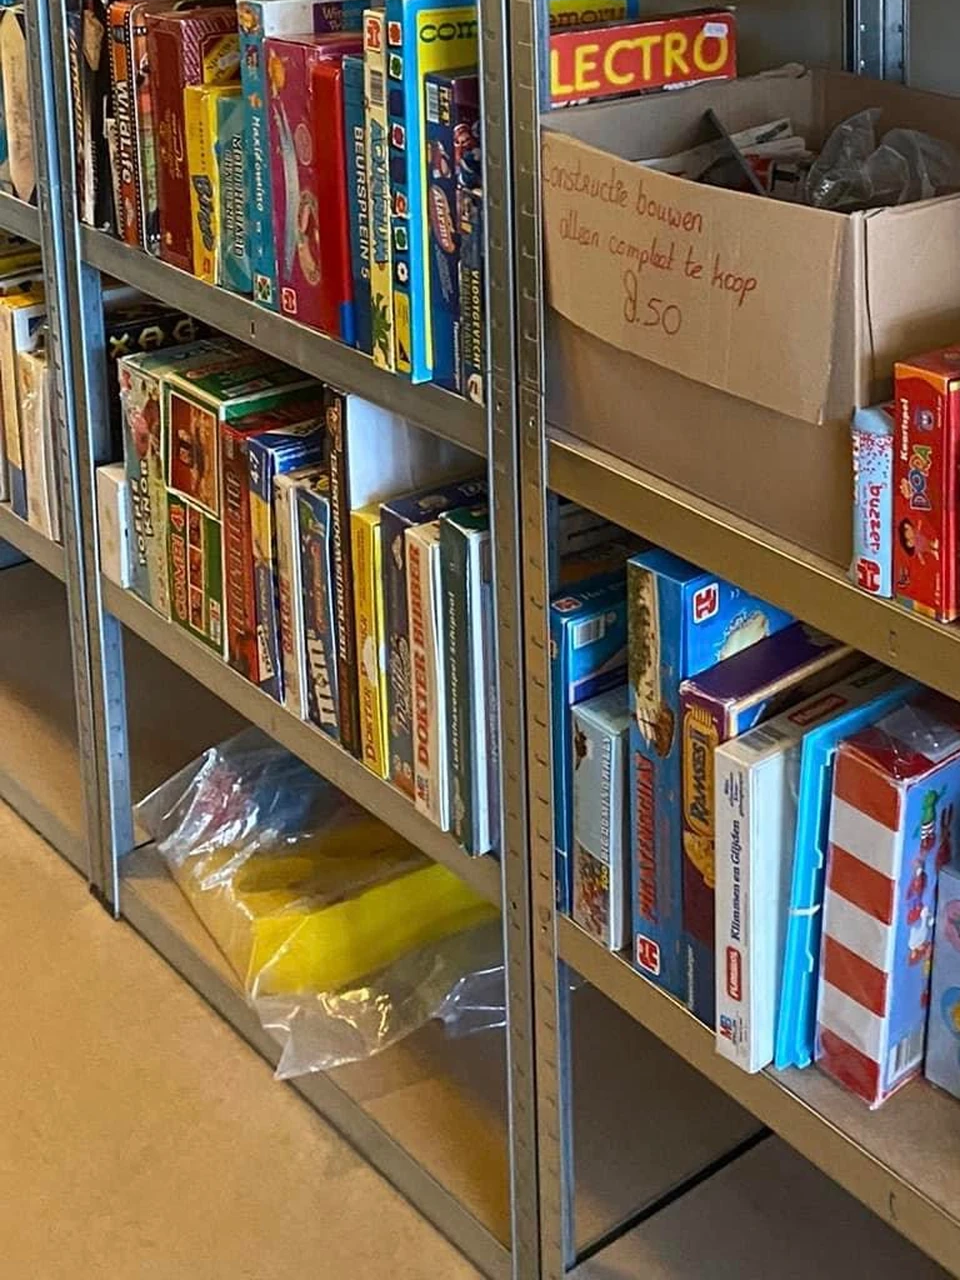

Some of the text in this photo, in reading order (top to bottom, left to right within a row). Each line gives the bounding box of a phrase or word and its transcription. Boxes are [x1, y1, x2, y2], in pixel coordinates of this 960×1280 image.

[550, 31, 729, 96] LECTRO
[352, 125, 370, 259] BEURSPLEIN
[637, 187, 704, 234] bouwen
[684, 254, 703, 280] te
[711, 259, 758, 308] koop
[471, 269, 482, 372] VLOOTGEVECHT
[899, 397, 910, 461] Kaartspel
[138, 458, 154, 537] KNOR
[908, 444, 932, 511] DORA
[868, 482, 883, 554] buzzer
[170, 532, 188, 621] COMBI
[409, 544, 429, 769] DOKTER BIBBER
[446, 590, 463, 772] Luchthavenspel Schiphol
[730, 820, 741, 866] Glijden
[730, 894, 741, 941] Klimmen
[720, 1014, 732, 1040] MB
